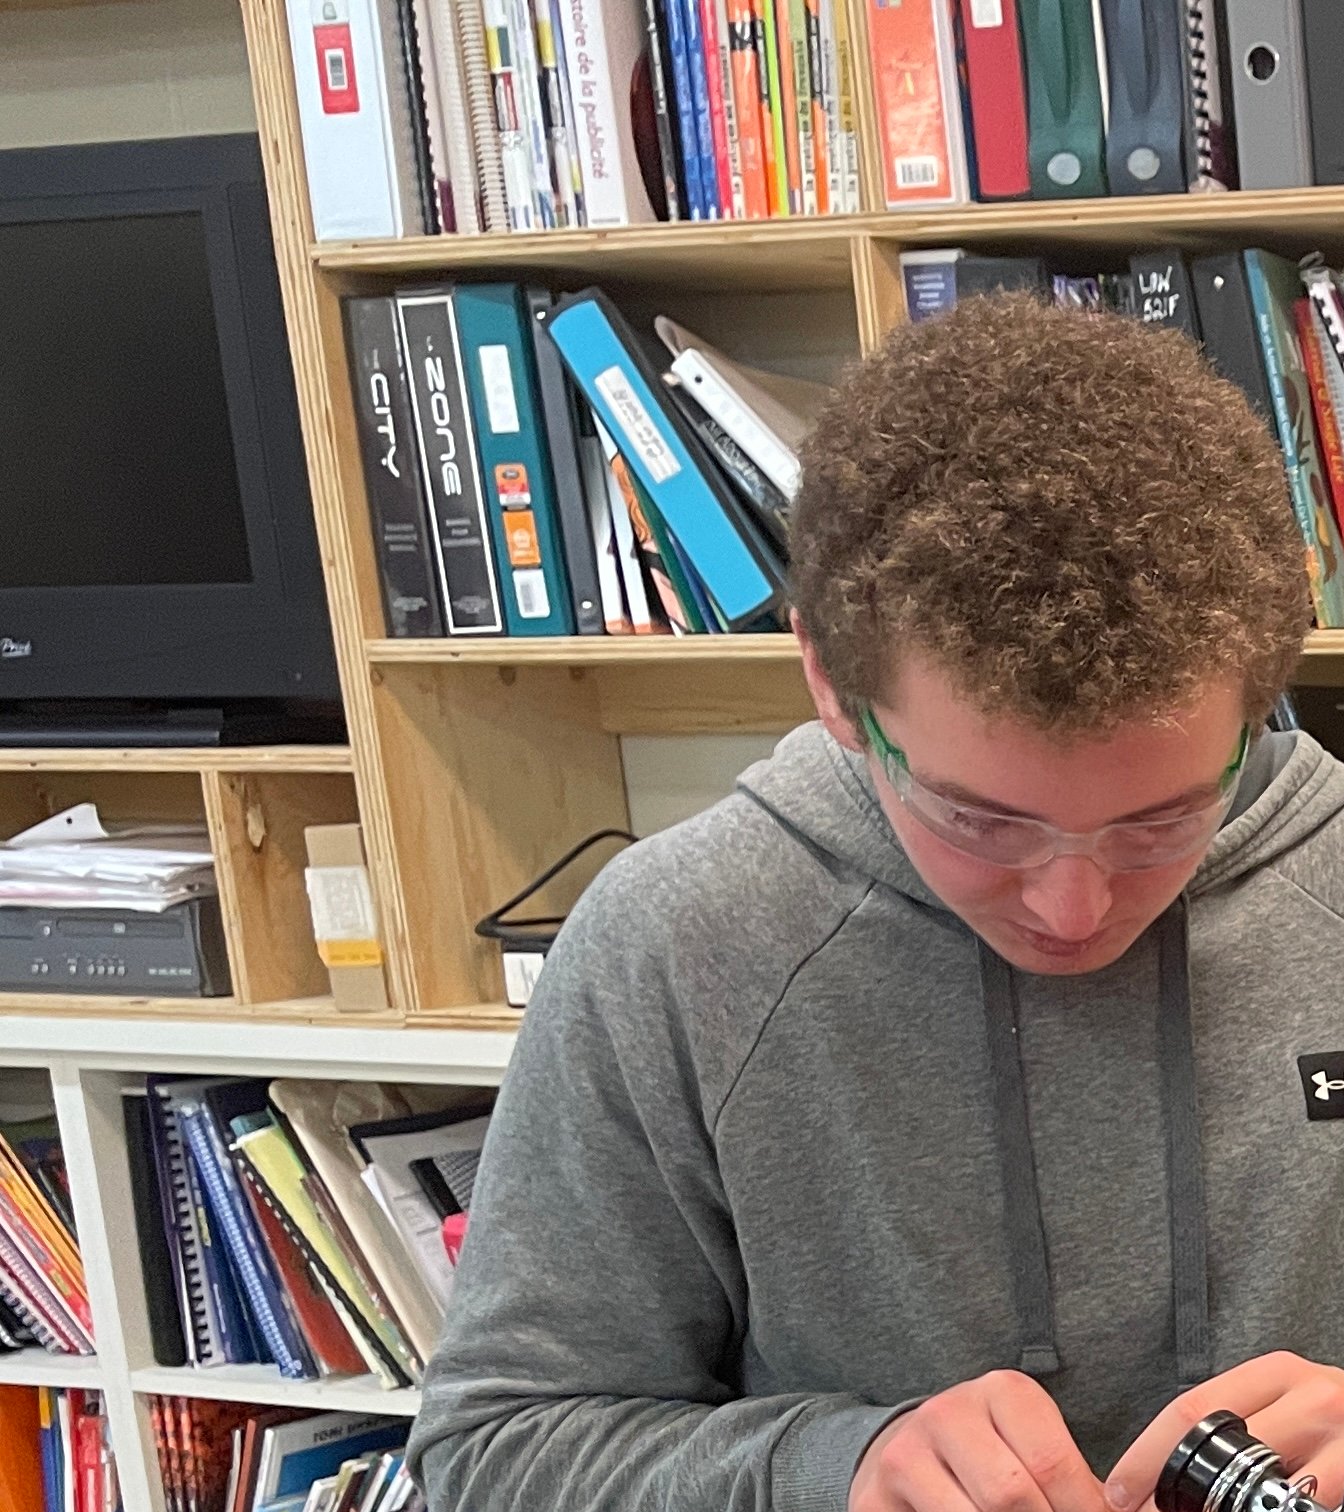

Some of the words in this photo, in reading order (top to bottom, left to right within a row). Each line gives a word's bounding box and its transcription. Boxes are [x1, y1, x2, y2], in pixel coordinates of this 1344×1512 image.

[577, 51, 595, 75] de
[581, 80, 597, 98] la
[370, 373, 400, 478] CITY
